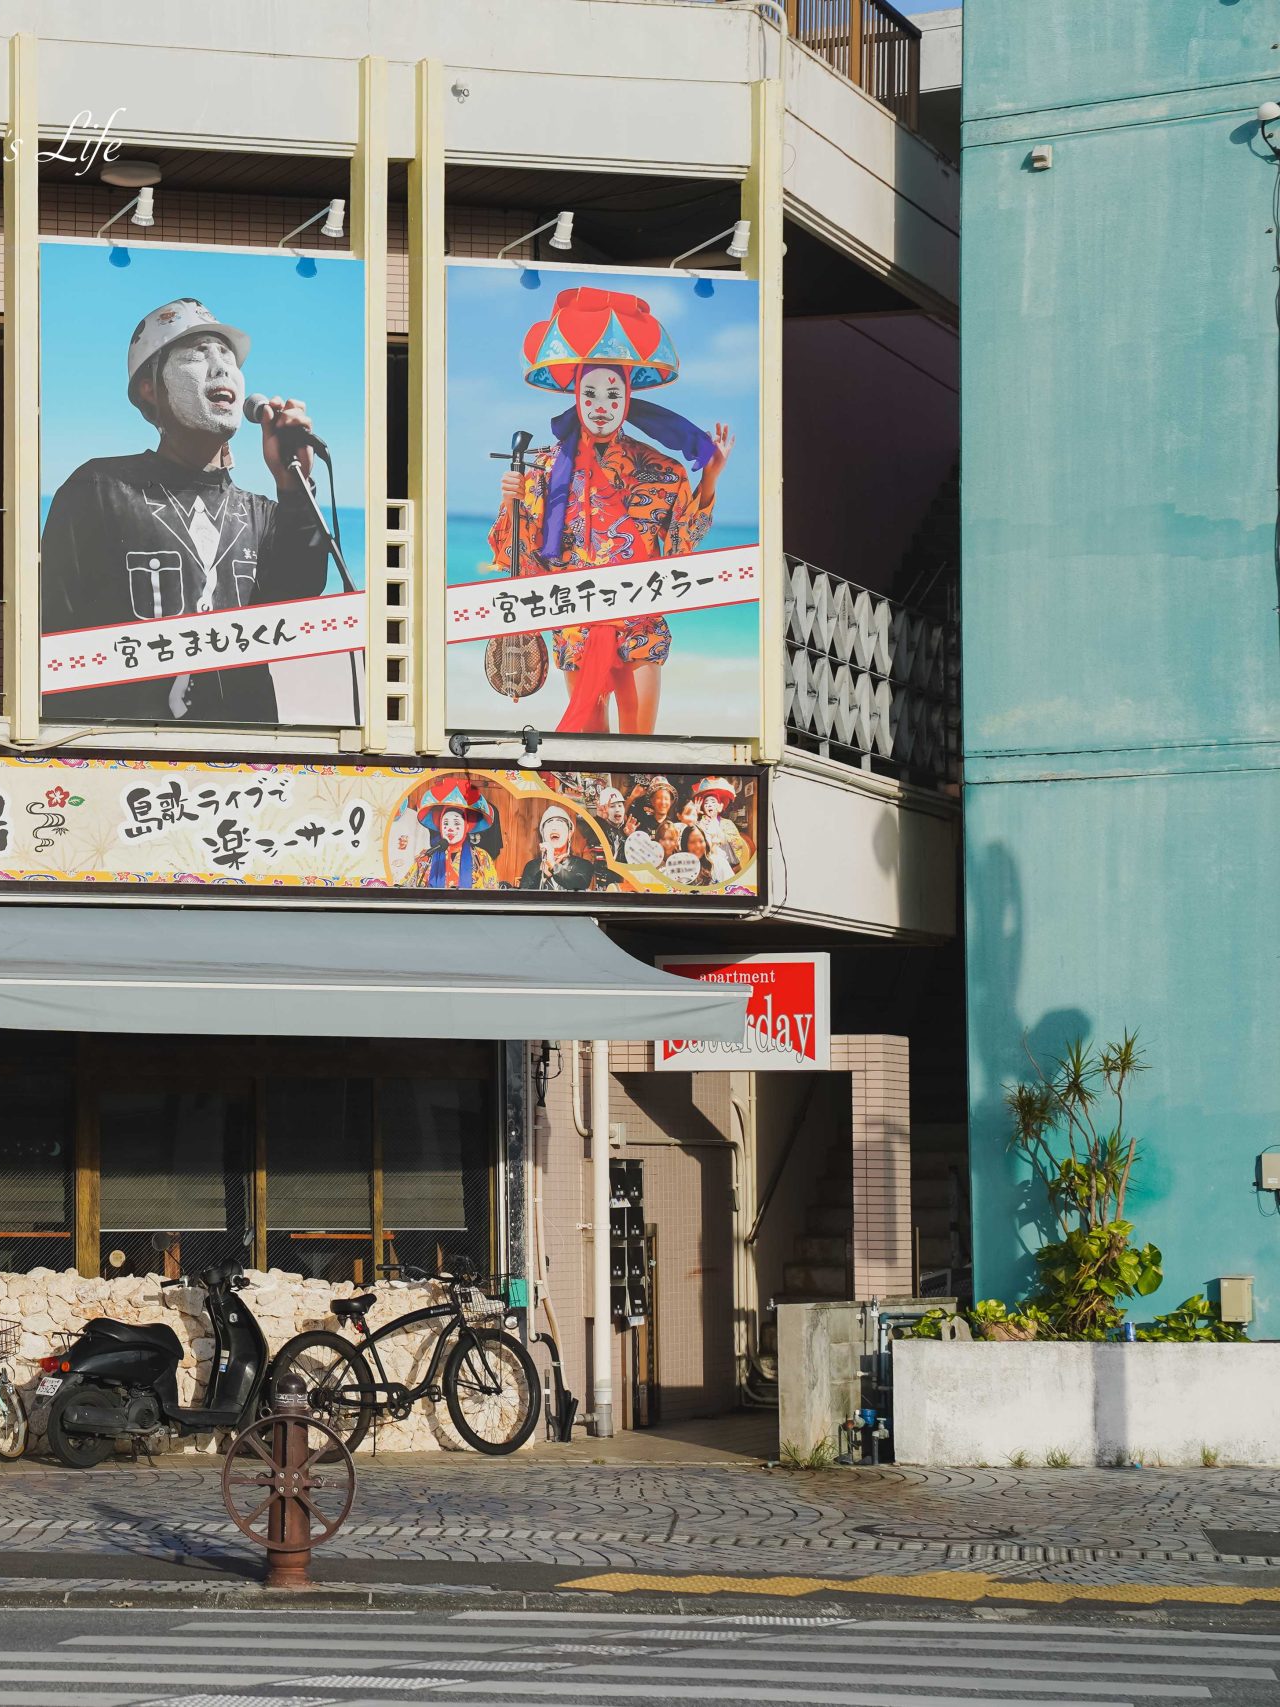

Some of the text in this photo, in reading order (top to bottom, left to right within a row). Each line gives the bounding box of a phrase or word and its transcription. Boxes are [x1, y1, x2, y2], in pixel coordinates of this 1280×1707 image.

[492, 569, 716, 625] 宮古島チョンダラー
[114, 618, 297, 669] 宮古まもるくん
[699, 970, 776, 984] apartment
[668, 993, 814, 1064] rday
